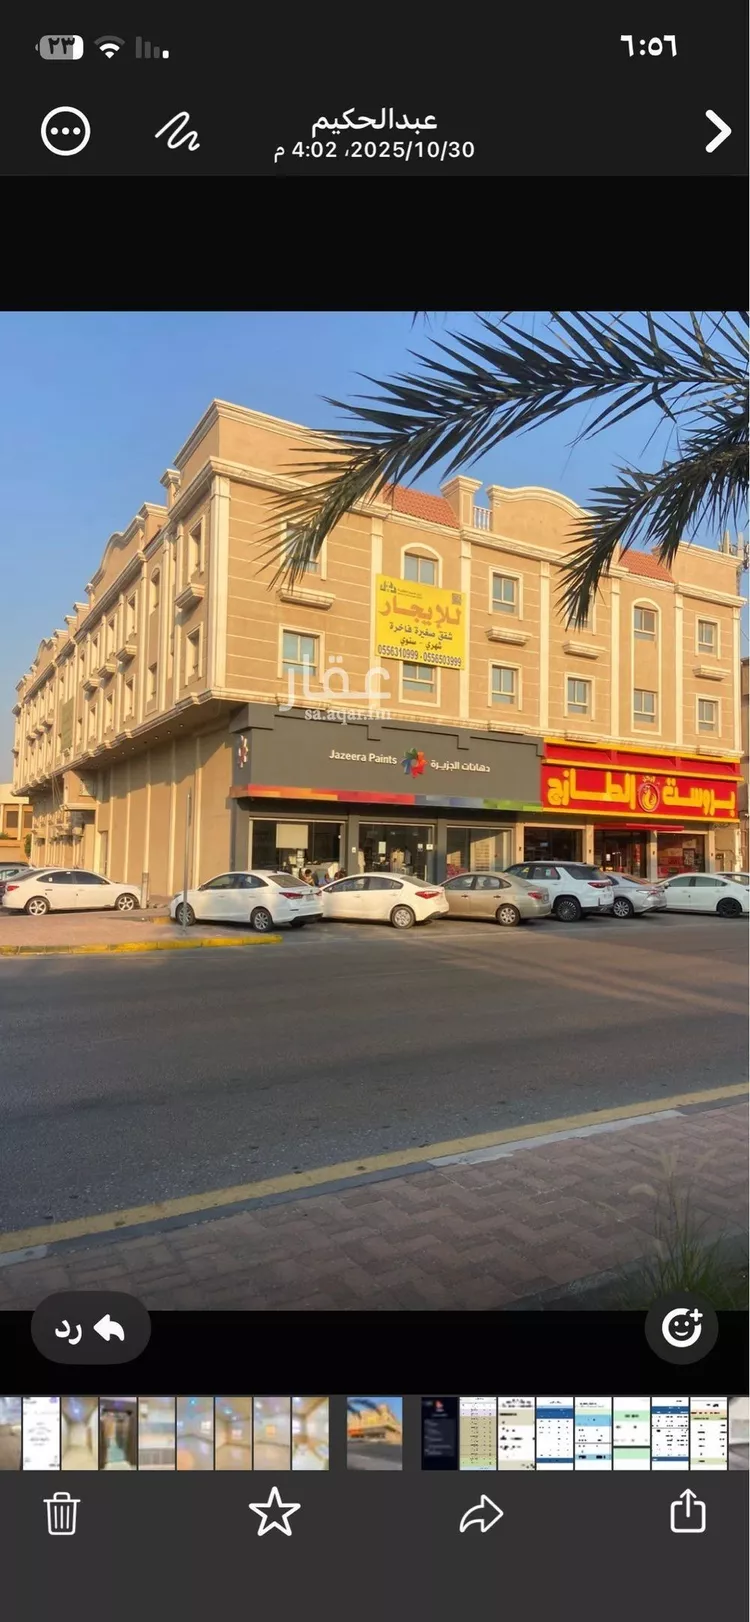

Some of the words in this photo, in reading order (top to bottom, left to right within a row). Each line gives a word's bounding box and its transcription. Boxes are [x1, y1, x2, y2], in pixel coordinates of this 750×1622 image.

[389, 621, 413, 634] فاخرة
[414, 626, 436, 639] صغيرة
[400, 636, 417, 646] سنوي
[437, 631, 453, 641] شقق
[425, 641, 442, 651] شهري
[377, 644, 419, 660] 0556310999
[423, 652, 462, 667] 0556503999
[329, 749, 367, 763] Jazeera
[369, 752, 398, 765] Paints
[430, 759, 460, 772] الجزيرة
[461, 761, 491, 773] دهانات
[547, 767, 636, 811] الطازج
[662, 778, 736, 818] بروست
